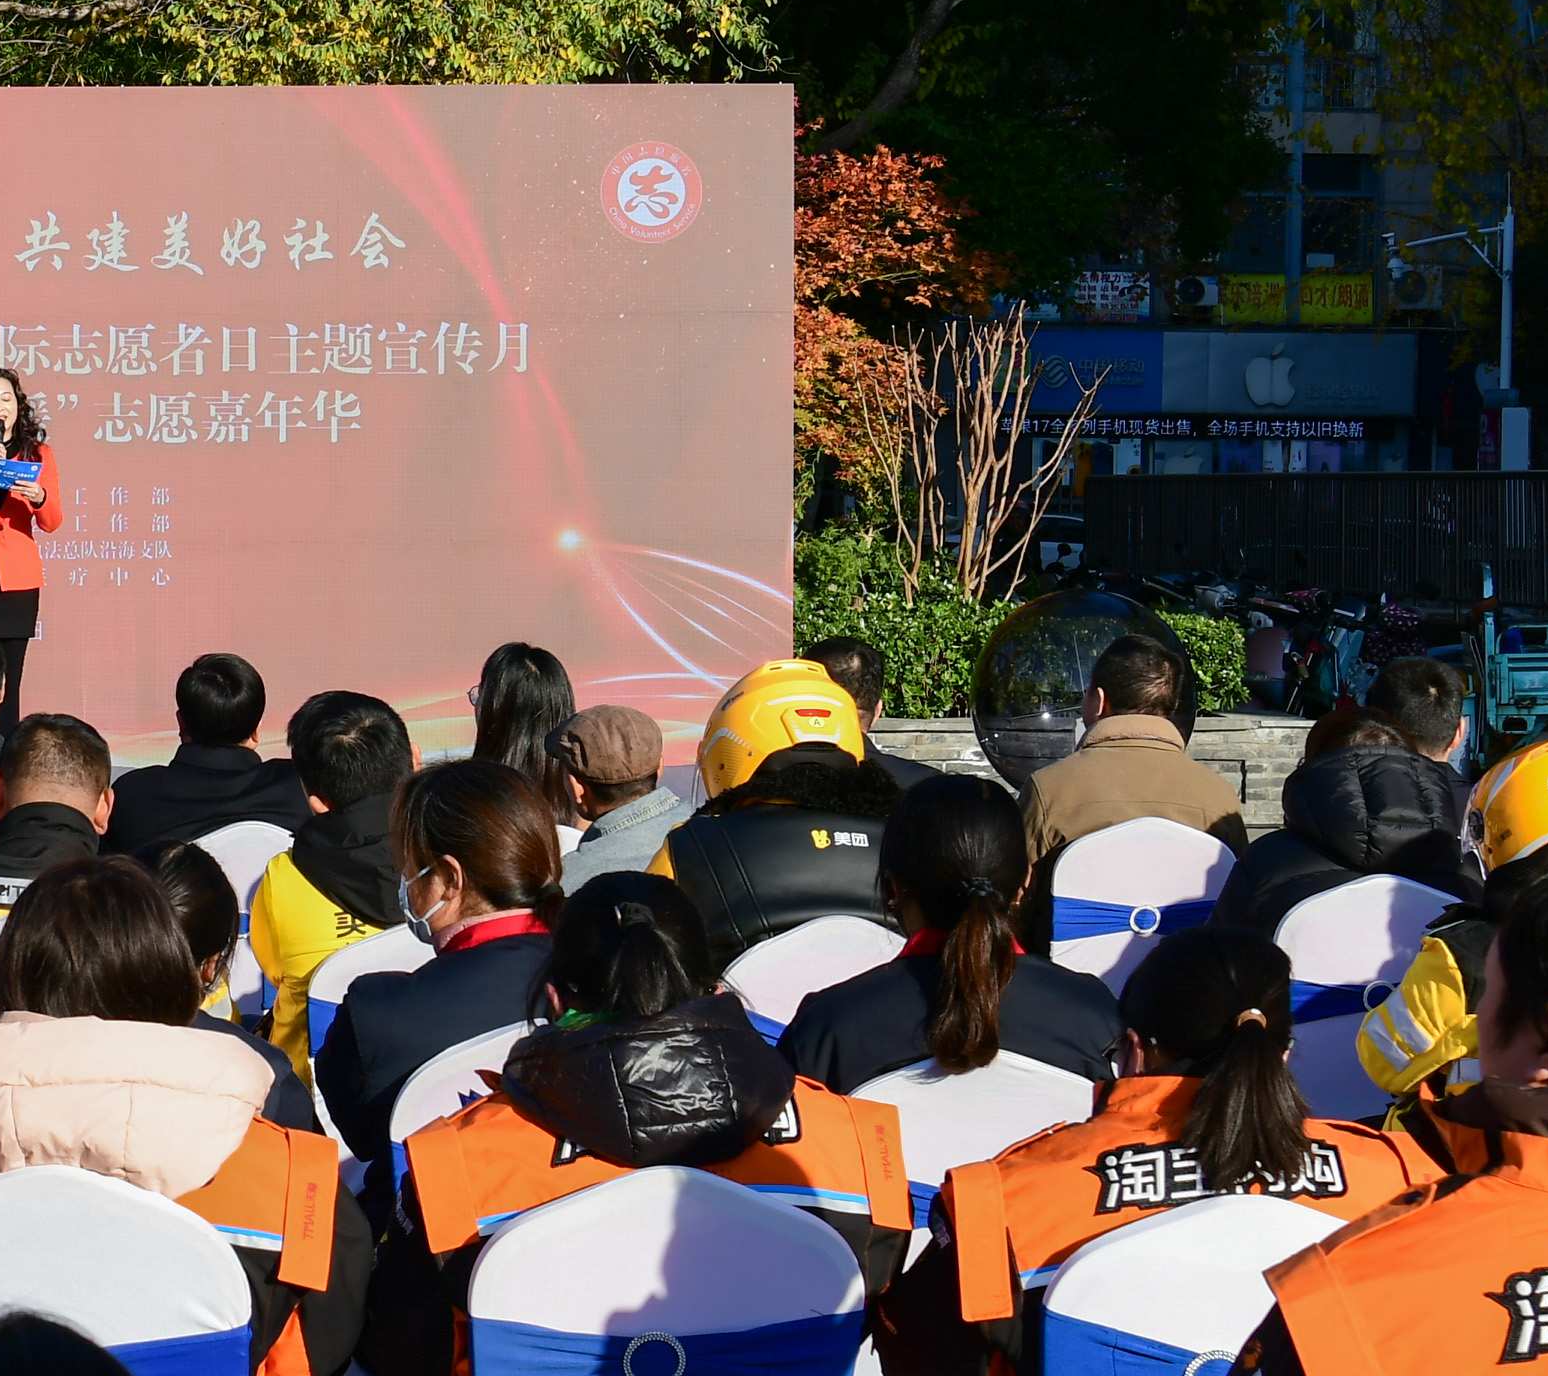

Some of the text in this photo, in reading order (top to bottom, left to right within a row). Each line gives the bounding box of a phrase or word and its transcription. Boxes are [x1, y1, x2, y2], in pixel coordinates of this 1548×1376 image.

[14, 210, 407, 276] 共建美好社会
[833, 831, 869, 848] 美团
